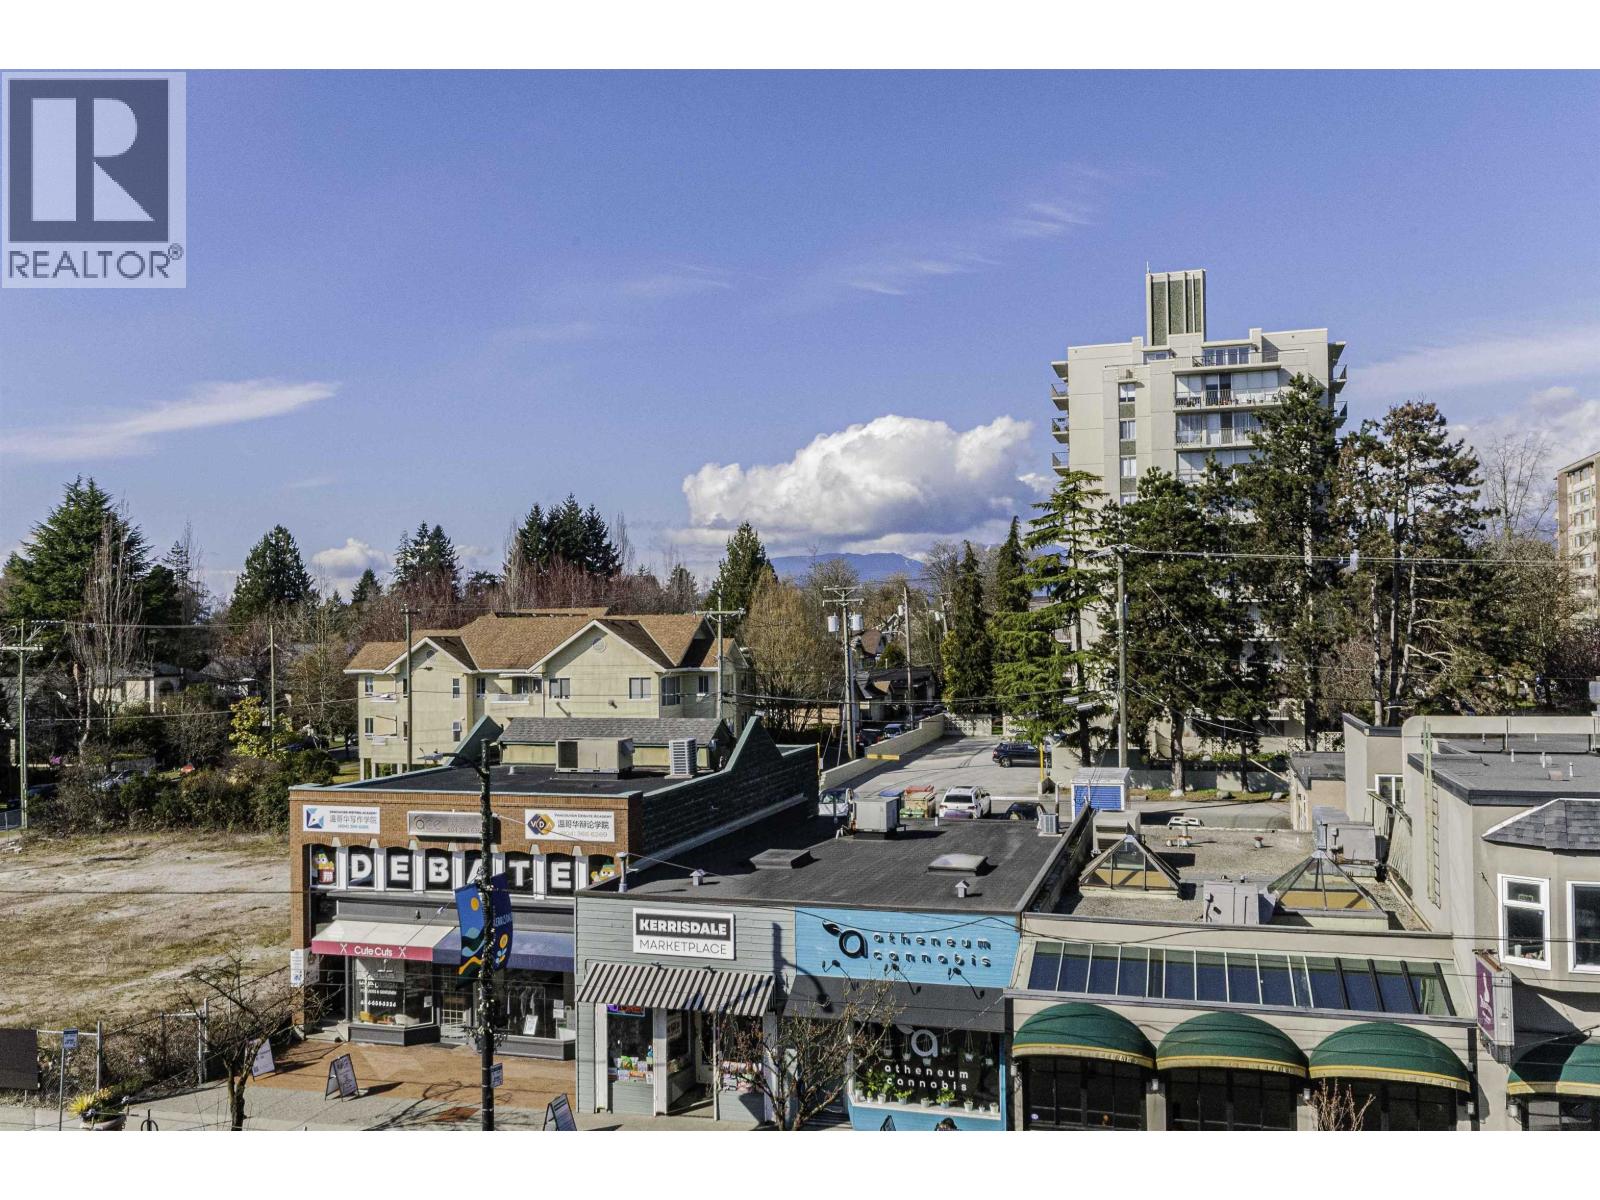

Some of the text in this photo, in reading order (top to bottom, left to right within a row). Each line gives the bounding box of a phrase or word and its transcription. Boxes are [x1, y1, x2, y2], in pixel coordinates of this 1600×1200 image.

[640, 918, 727, 936] KERRISDALE
[640, 939, 727, 955] MARKETPLACE
[873, 931, 992, 951] atheneum
[354, 945, 392, 957] Cute Cuts
[873, 950, 992, 968] cannabis
[884, 1064, 969, 1079] atheneum
[886, 1077, 968, 1092] cannabis
